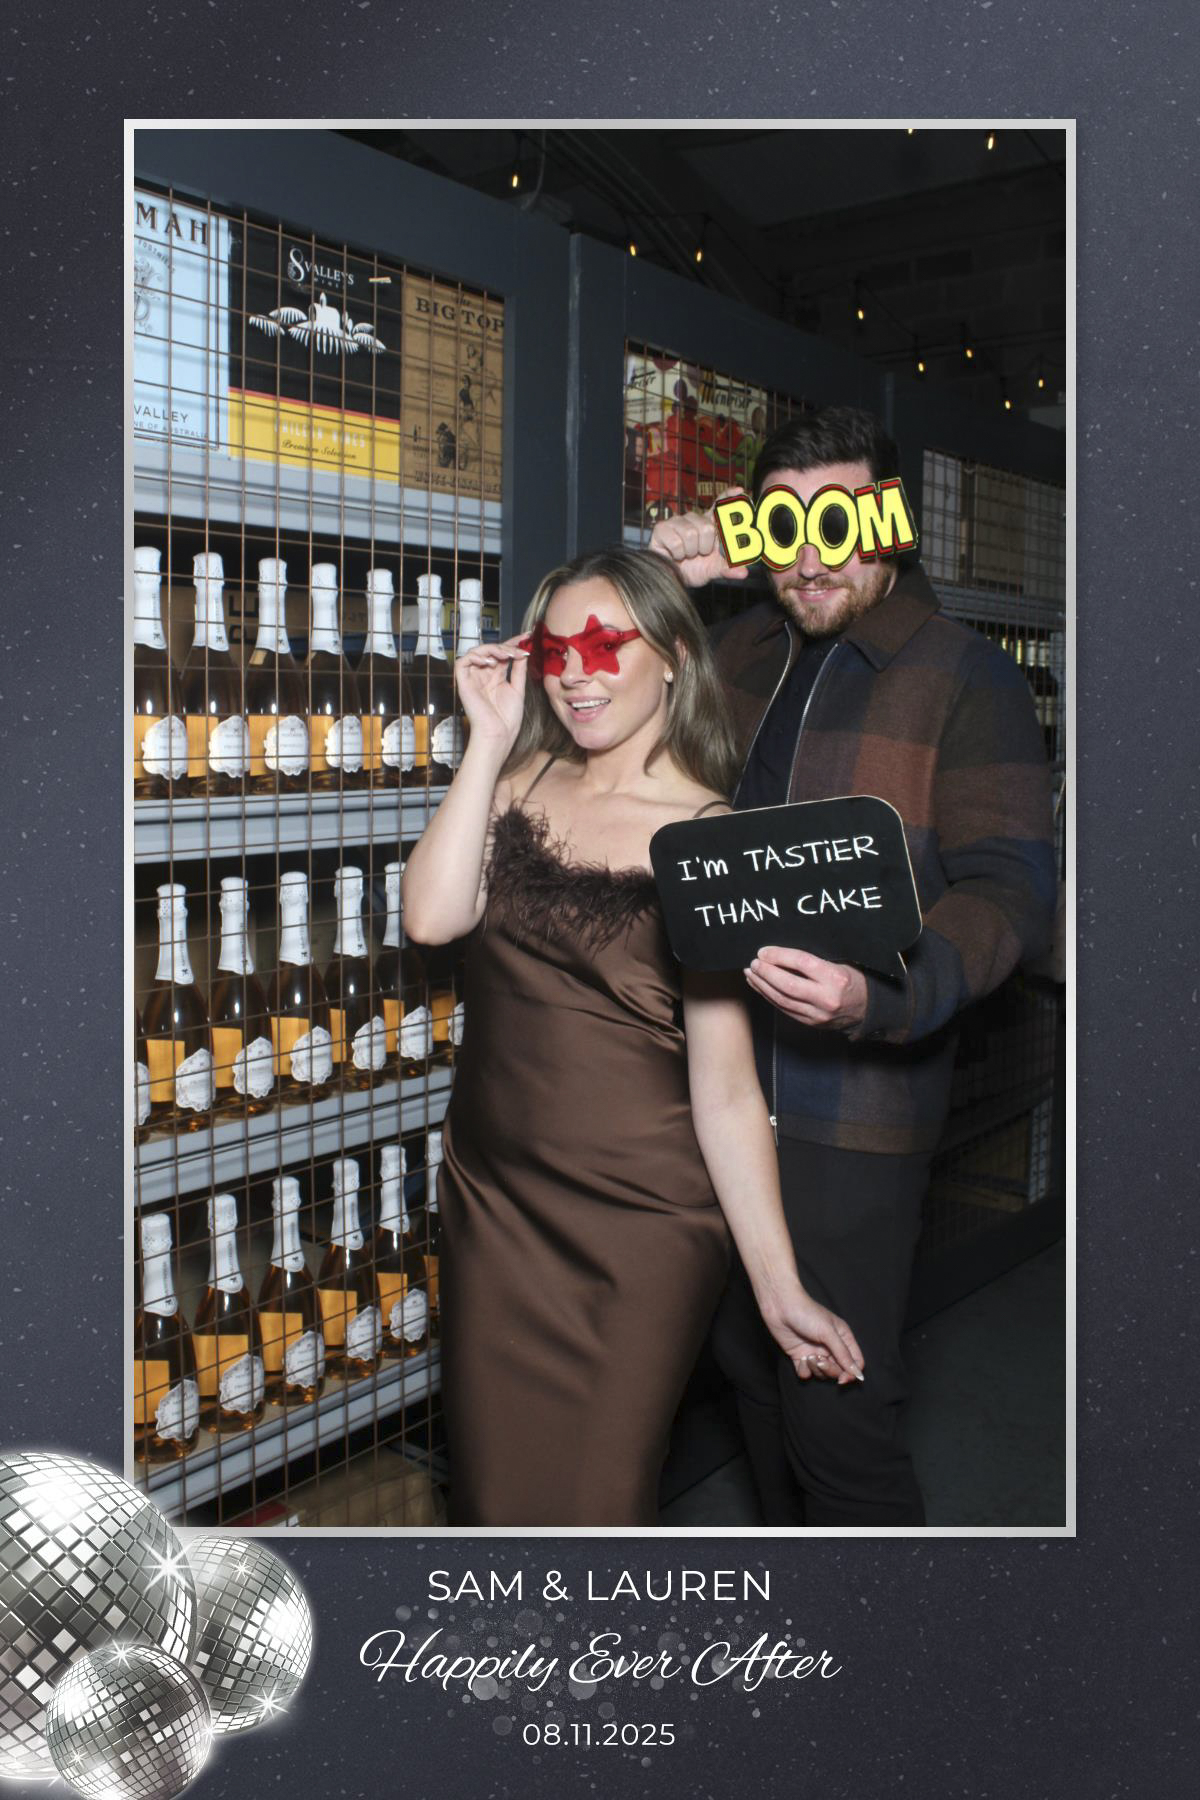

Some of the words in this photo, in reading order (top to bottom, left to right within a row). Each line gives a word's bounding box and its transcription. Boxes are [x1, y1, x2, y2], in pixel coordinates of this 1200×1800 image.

[416, 296, 456, 321] BIG
[461, 308, 504, 333] TOP
[134, 403, 189, 424] VALLEY
[163, 426, 209, 439] ASTRALIA
[714, 478, 916, 571] BOOM
[677, 856, 729, 881] I'm
[694, 898, 780, 927] THAN
[797, 886, 883, 915] CAKE
